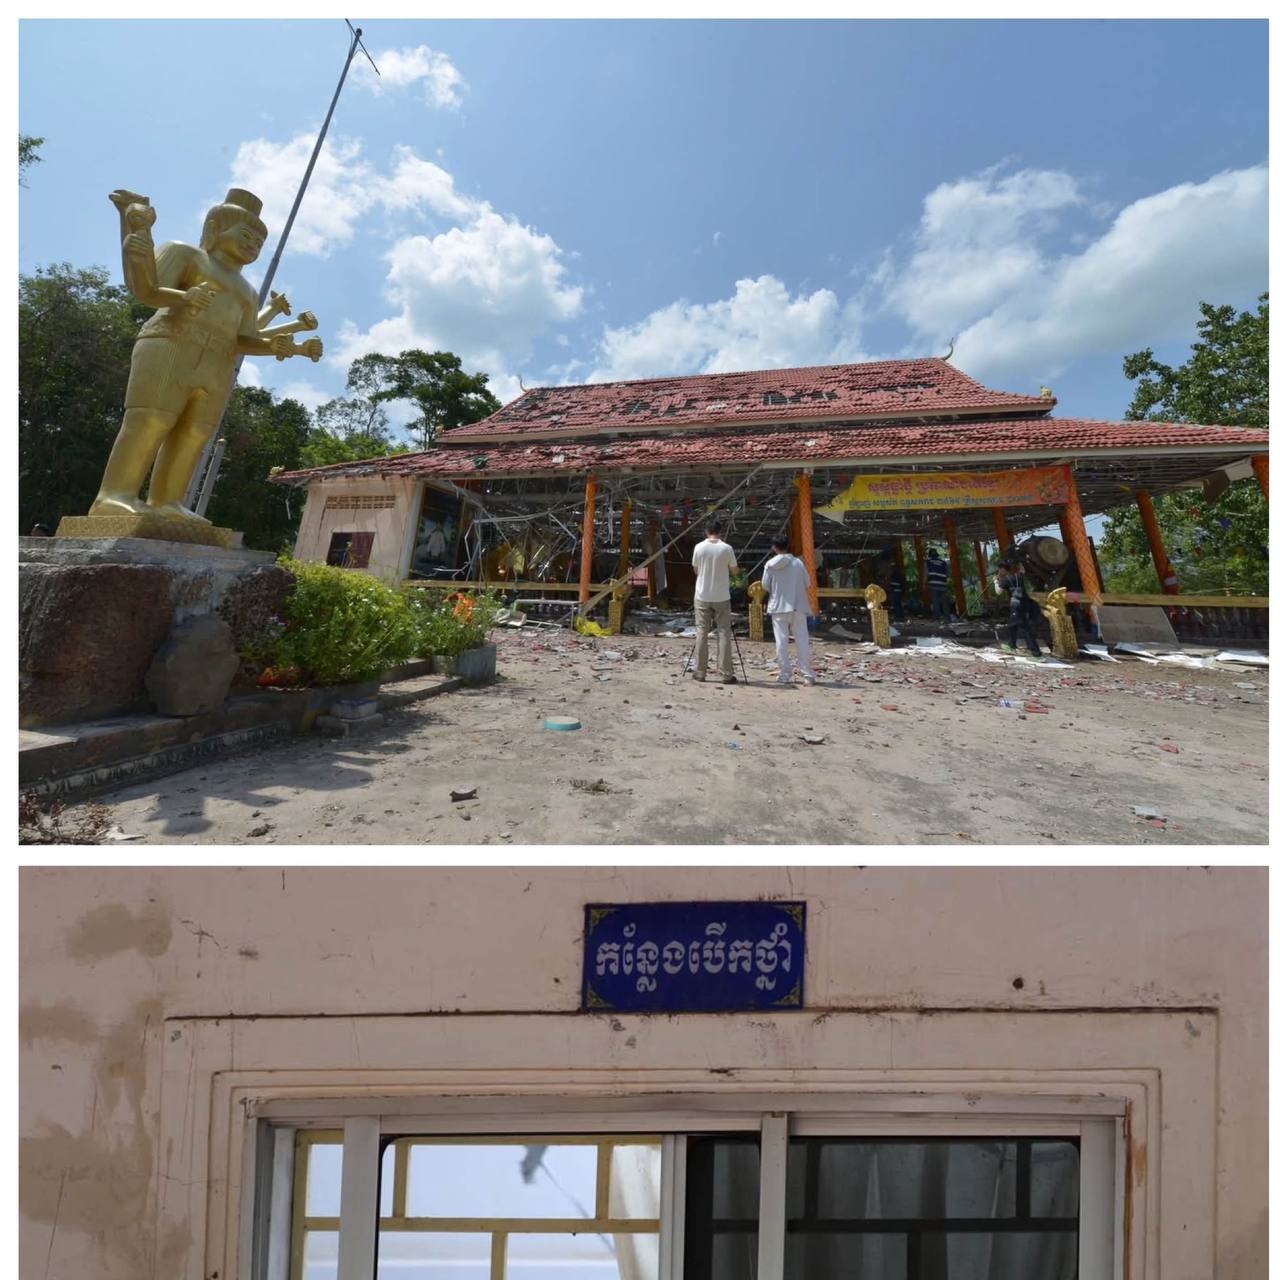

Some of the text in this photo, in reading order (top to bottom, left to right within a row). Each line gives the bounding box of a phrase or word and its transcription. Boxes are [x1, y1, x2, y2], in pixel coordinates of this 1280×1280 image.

[596, 922, 792, 992] កន្លែងបើកថ្នាំ
